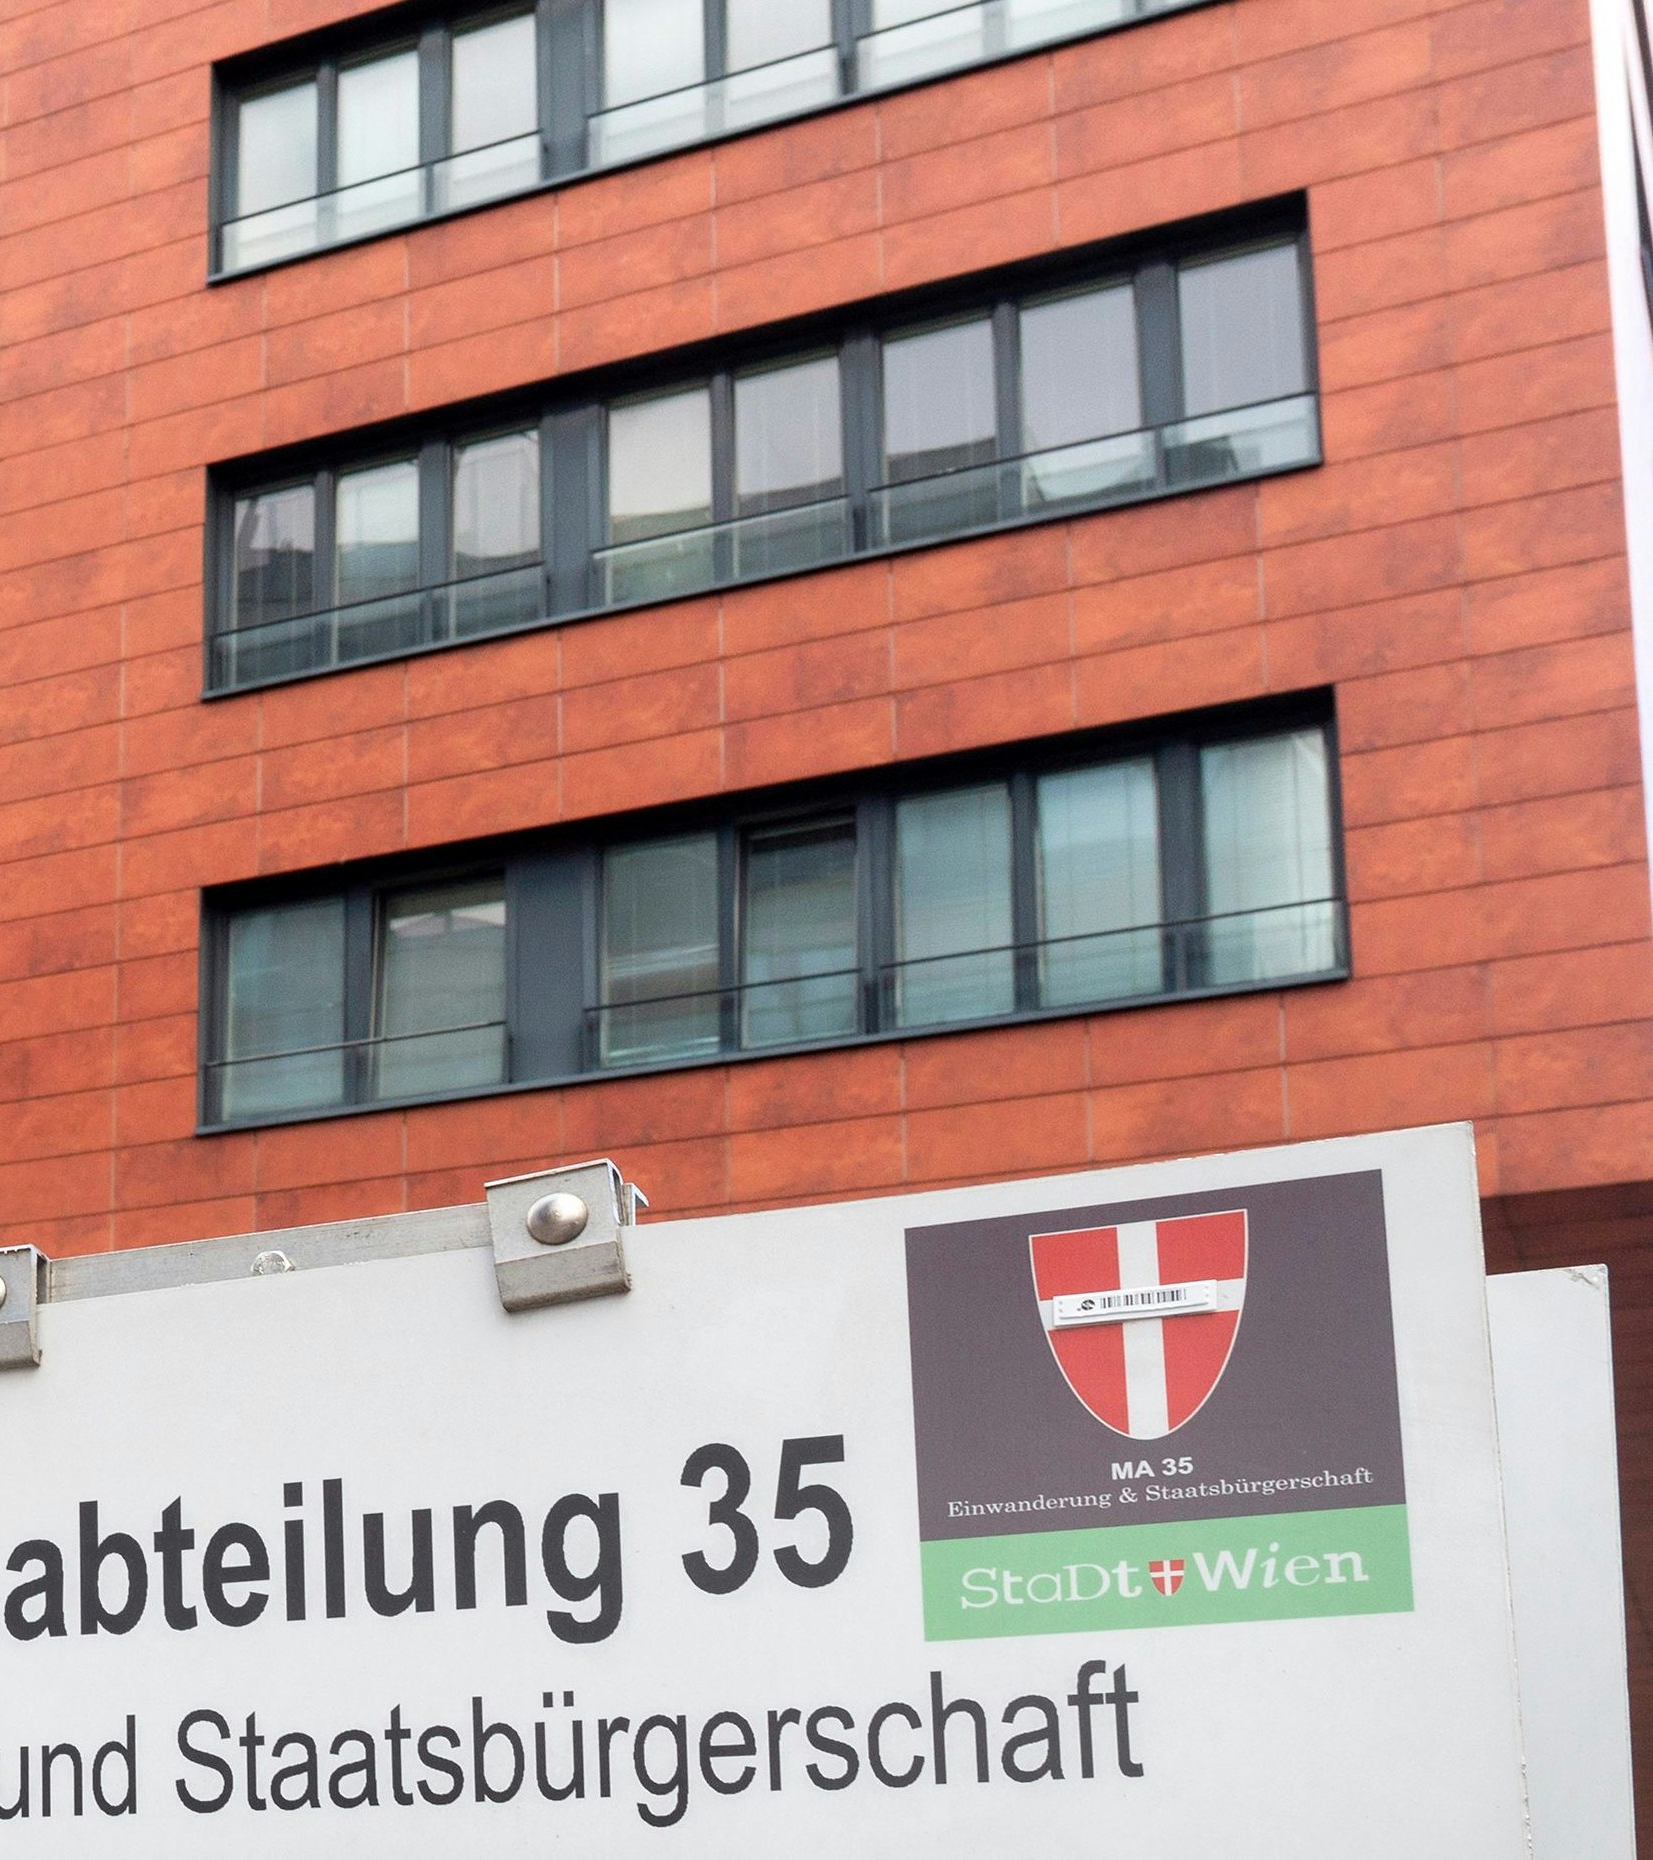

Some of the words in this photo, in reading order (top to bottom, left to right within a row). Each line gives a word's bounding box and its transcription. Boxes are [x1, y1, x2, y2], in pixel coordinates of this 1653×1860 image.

[947, 1490, 1111, 1518] Einwanderung
[1119, 1487, 1137, 1503] &
[1145, 1467, 1373, 1502] Staatsbürgerschaft
[1111, 1461, 1155, 1480] MA
[1162, 1457, 1193, 1476] 35
[680, 1434, 853, 1594] 35
[1193, 1542, 1369, 1592] Wien
[175, 1660, 1144, 1828] Staatsbürgerschaft
